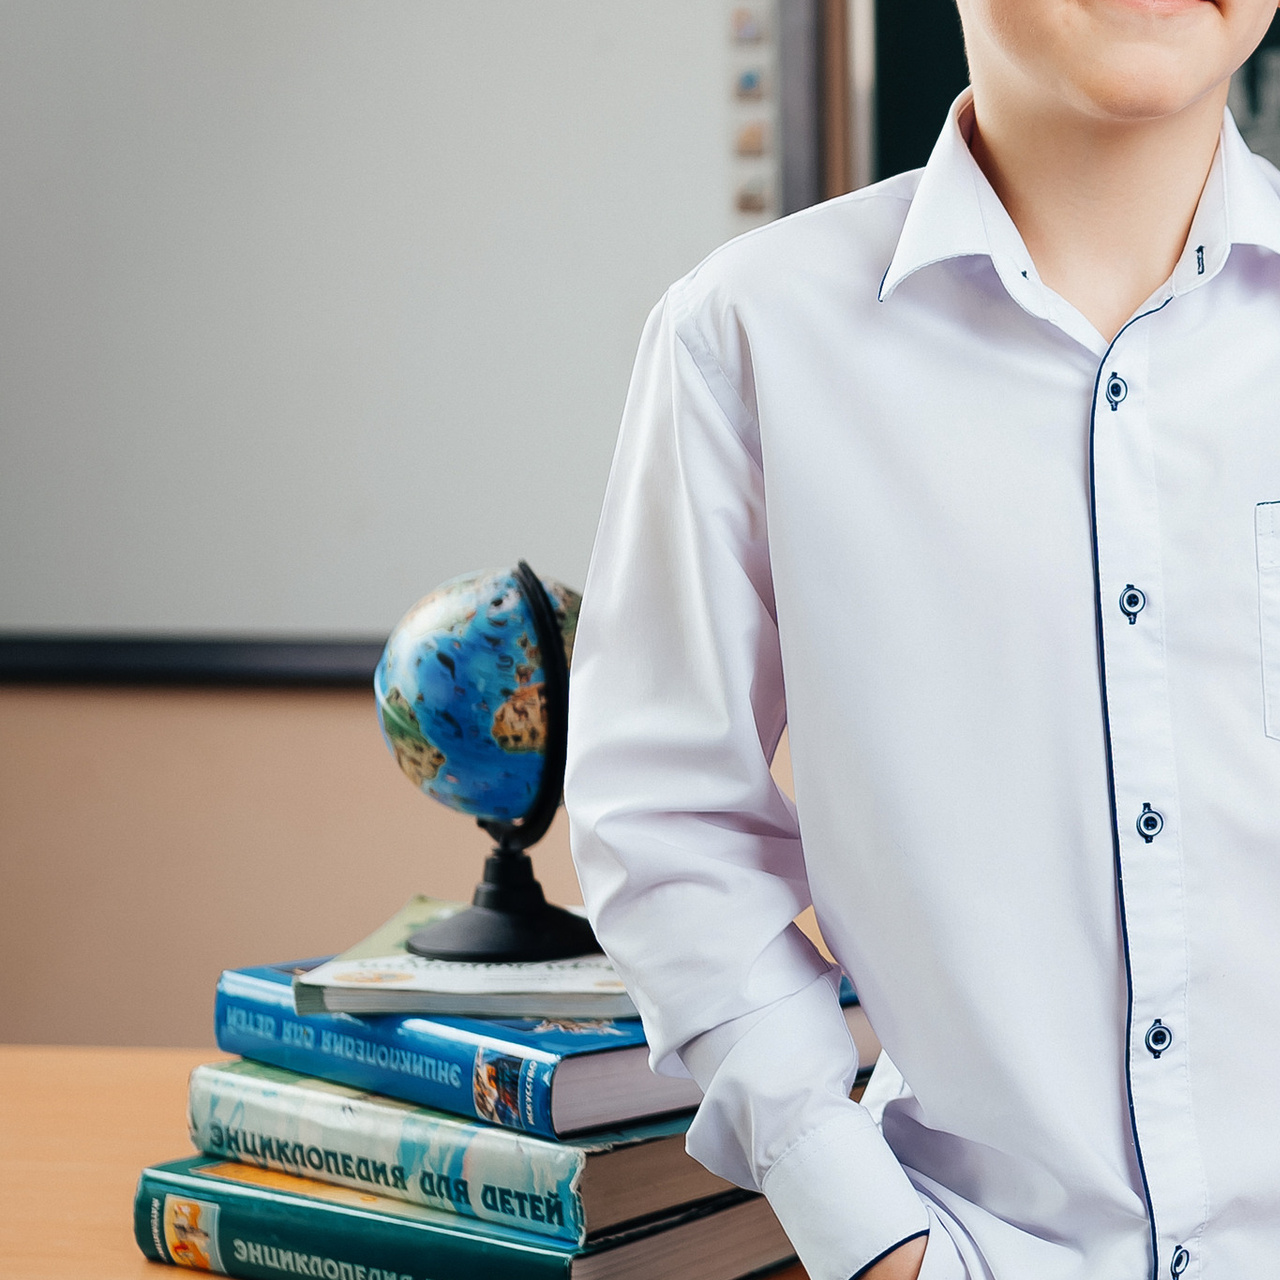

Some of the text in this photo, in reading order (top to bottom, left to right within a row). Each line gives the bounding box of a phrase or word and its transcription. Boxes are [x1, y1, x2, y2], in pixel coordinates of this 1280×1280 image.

[226, 1005, 462, 1088] ЭНЦИКЛОПЕДИЯ ДЛЯ ДЕТЕЙ
[210, 1122, 565, 1227] ЭНЦИКЛОПЕДИЯ ДЛЯ ДЕТЕЙ
